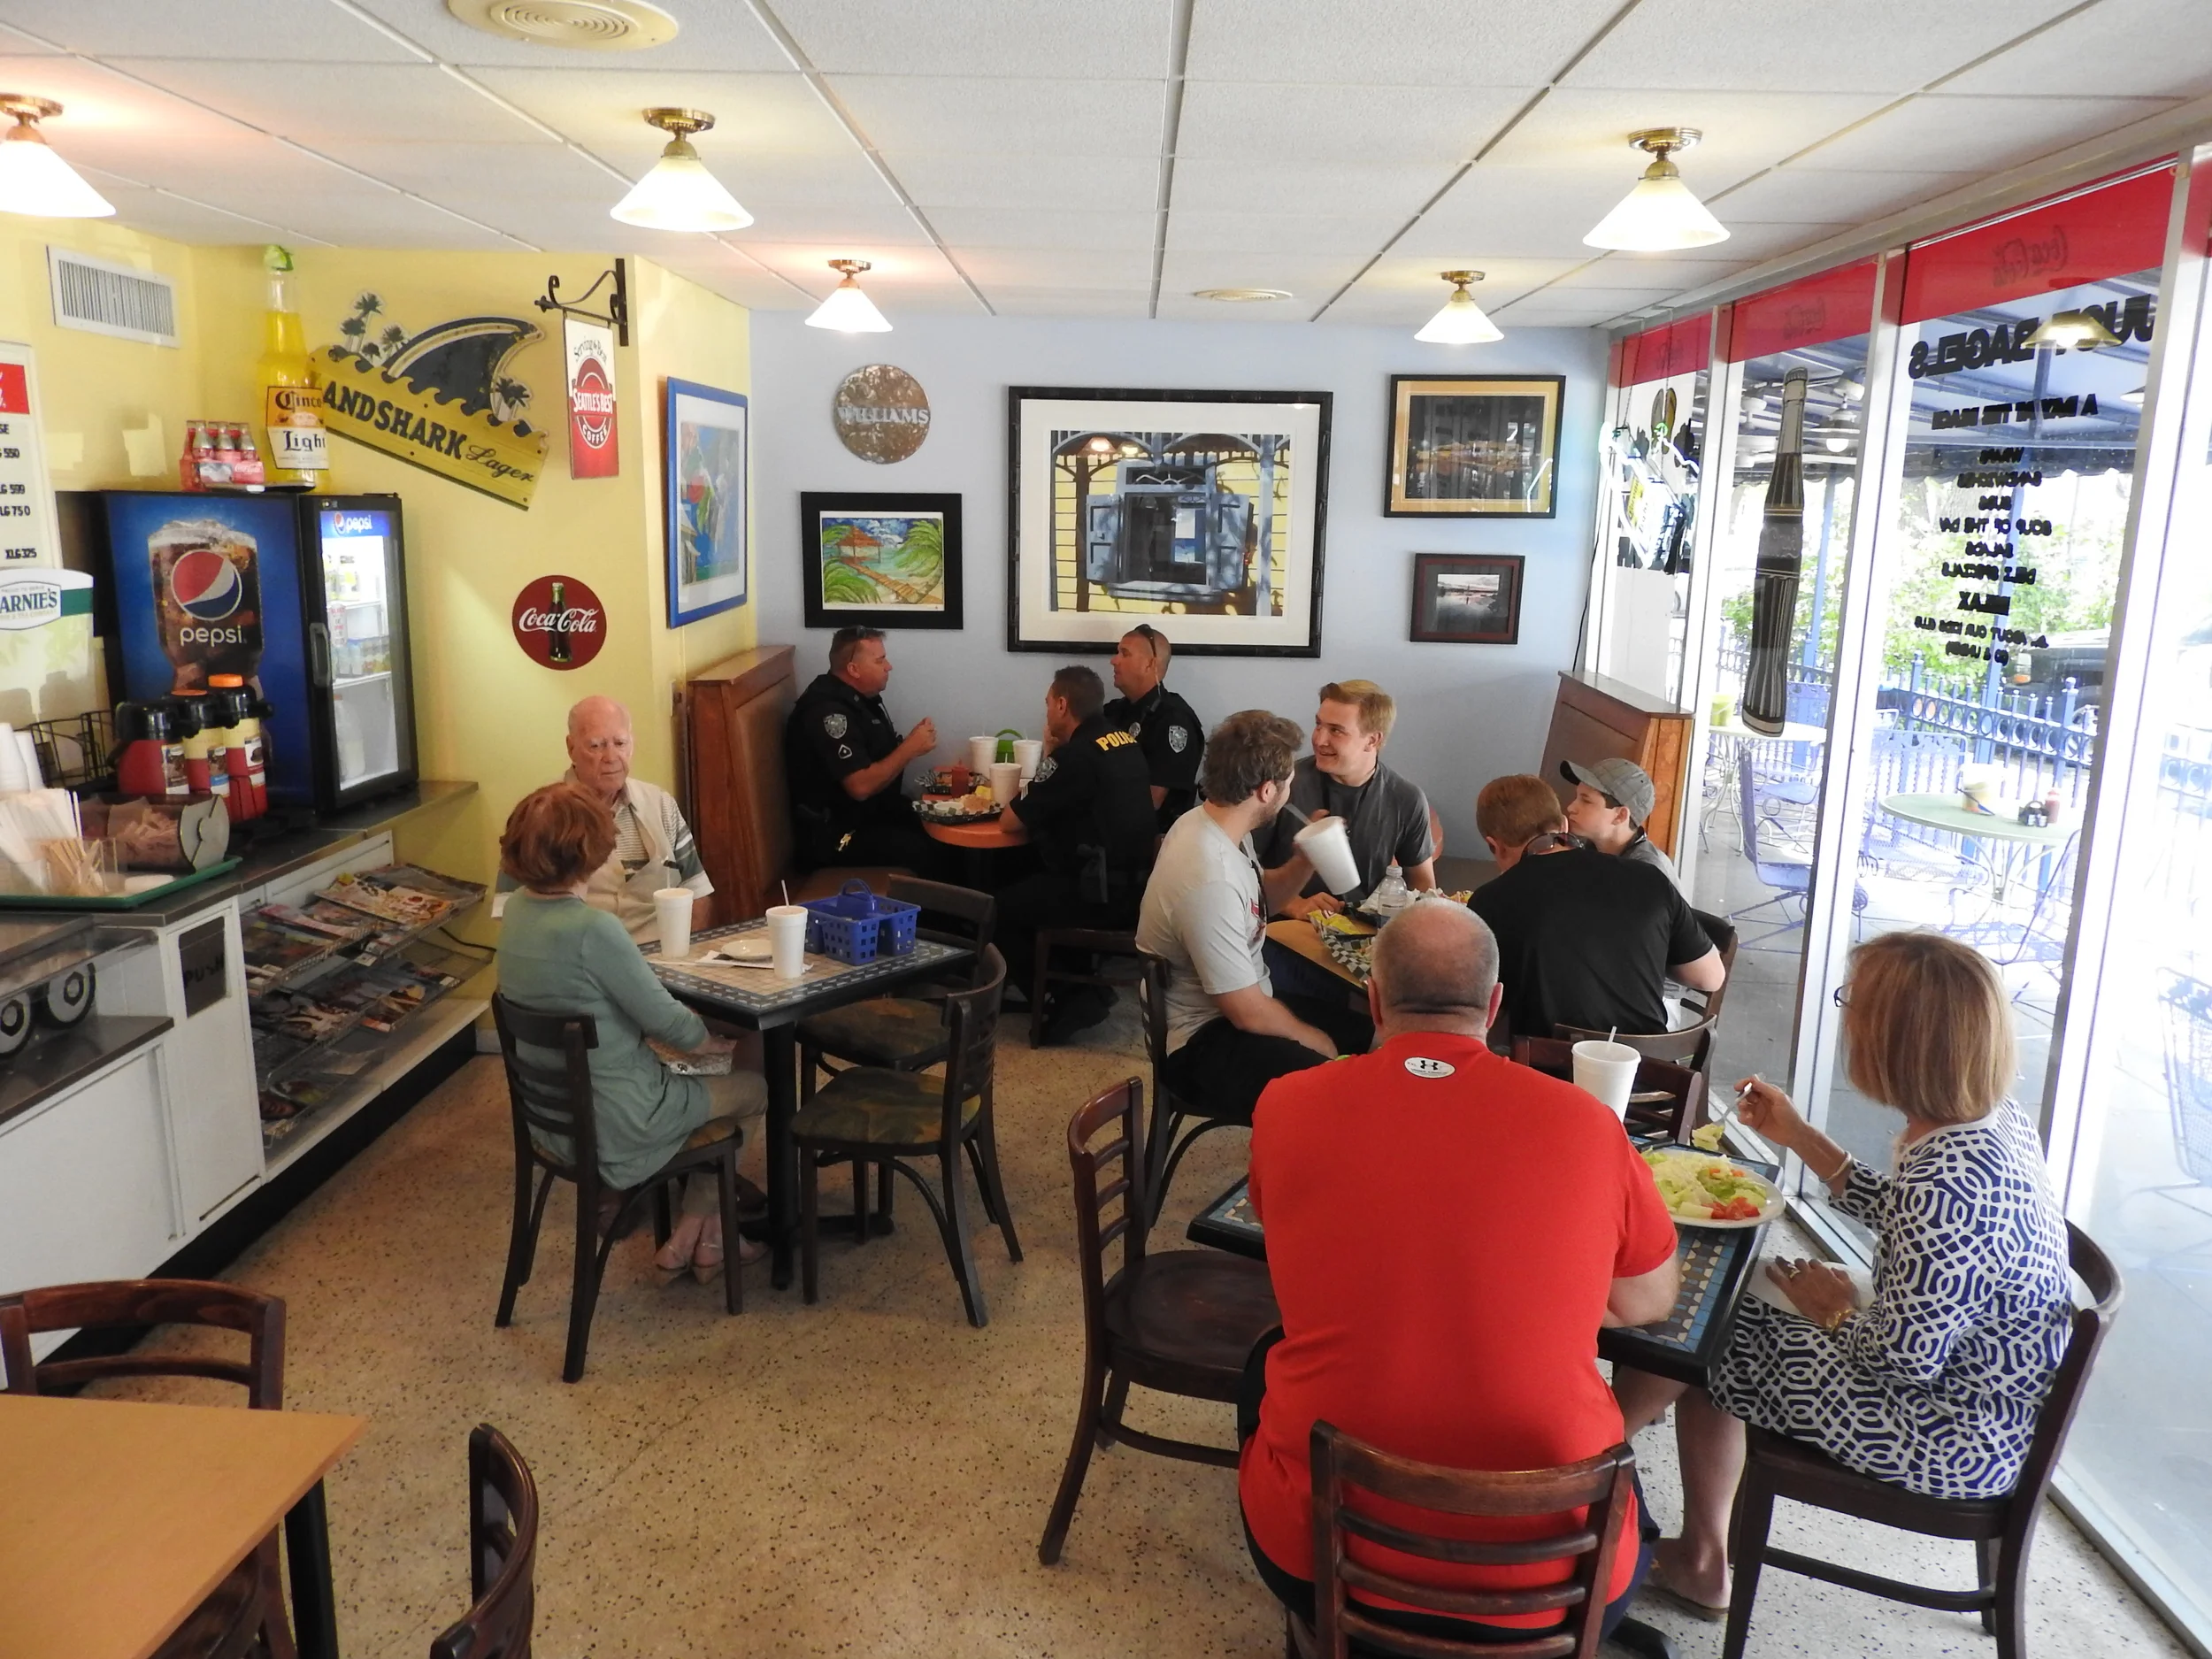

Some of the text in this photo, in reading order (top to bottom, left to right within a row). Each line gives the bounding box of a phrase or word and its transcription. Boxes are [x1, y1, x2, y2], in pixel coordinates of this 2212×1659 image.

[275, 390, 322, 413] Cinco
[600, 392, 613, 415] BEST
[323, 380, 534, 482] ANDSHARK Lager
[582, 424, 608, 444] COFFEE
[12, 505, 31, 517] 750
[346, 514, 373, 534] pepsi
[0, 588, 58, 614] ARNIE'S
[518, 607, 599, 633] Coca-Cola
[180, 625, 243, 647] pepsi
[1095, 731, 1138, 751] POLIC
